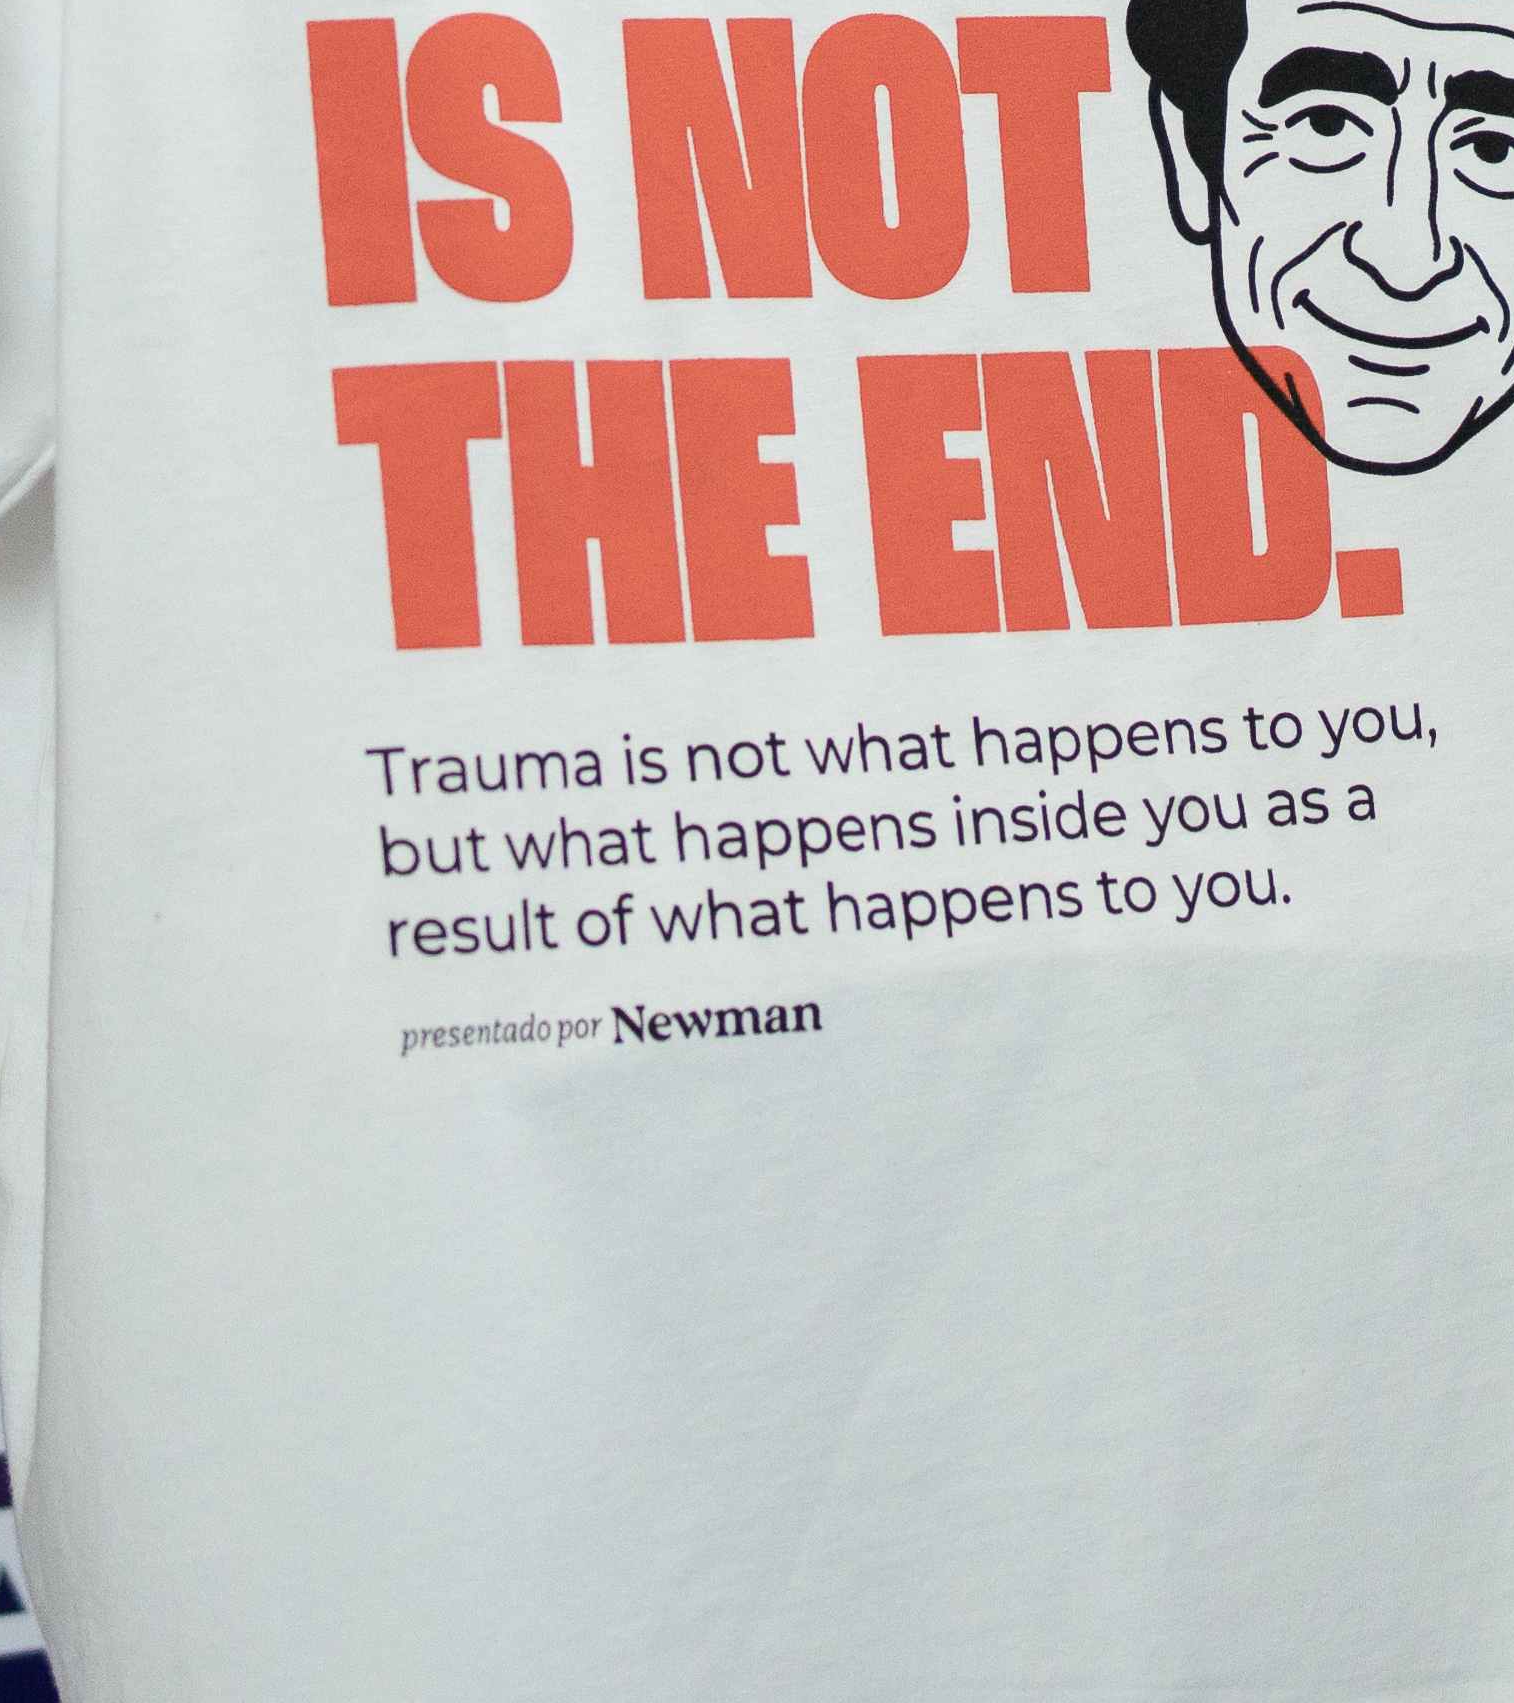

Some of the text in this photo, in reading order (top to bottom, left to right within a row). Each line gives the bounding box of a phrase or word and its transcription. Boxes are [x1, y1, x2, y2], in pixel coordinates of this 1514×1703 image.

[306, 12, 1112, 306] IS NOT
[331, 345, 1404, 651] THE END.
[365, 701, 1439, 795] Trauma is not what happens to you,
[379, 783, 1377, 878] but what happens inside you as a
[389, 867, 1292, 959] result of what happens to you.
[400, 1001, 822, 1057] presentado por Newman
